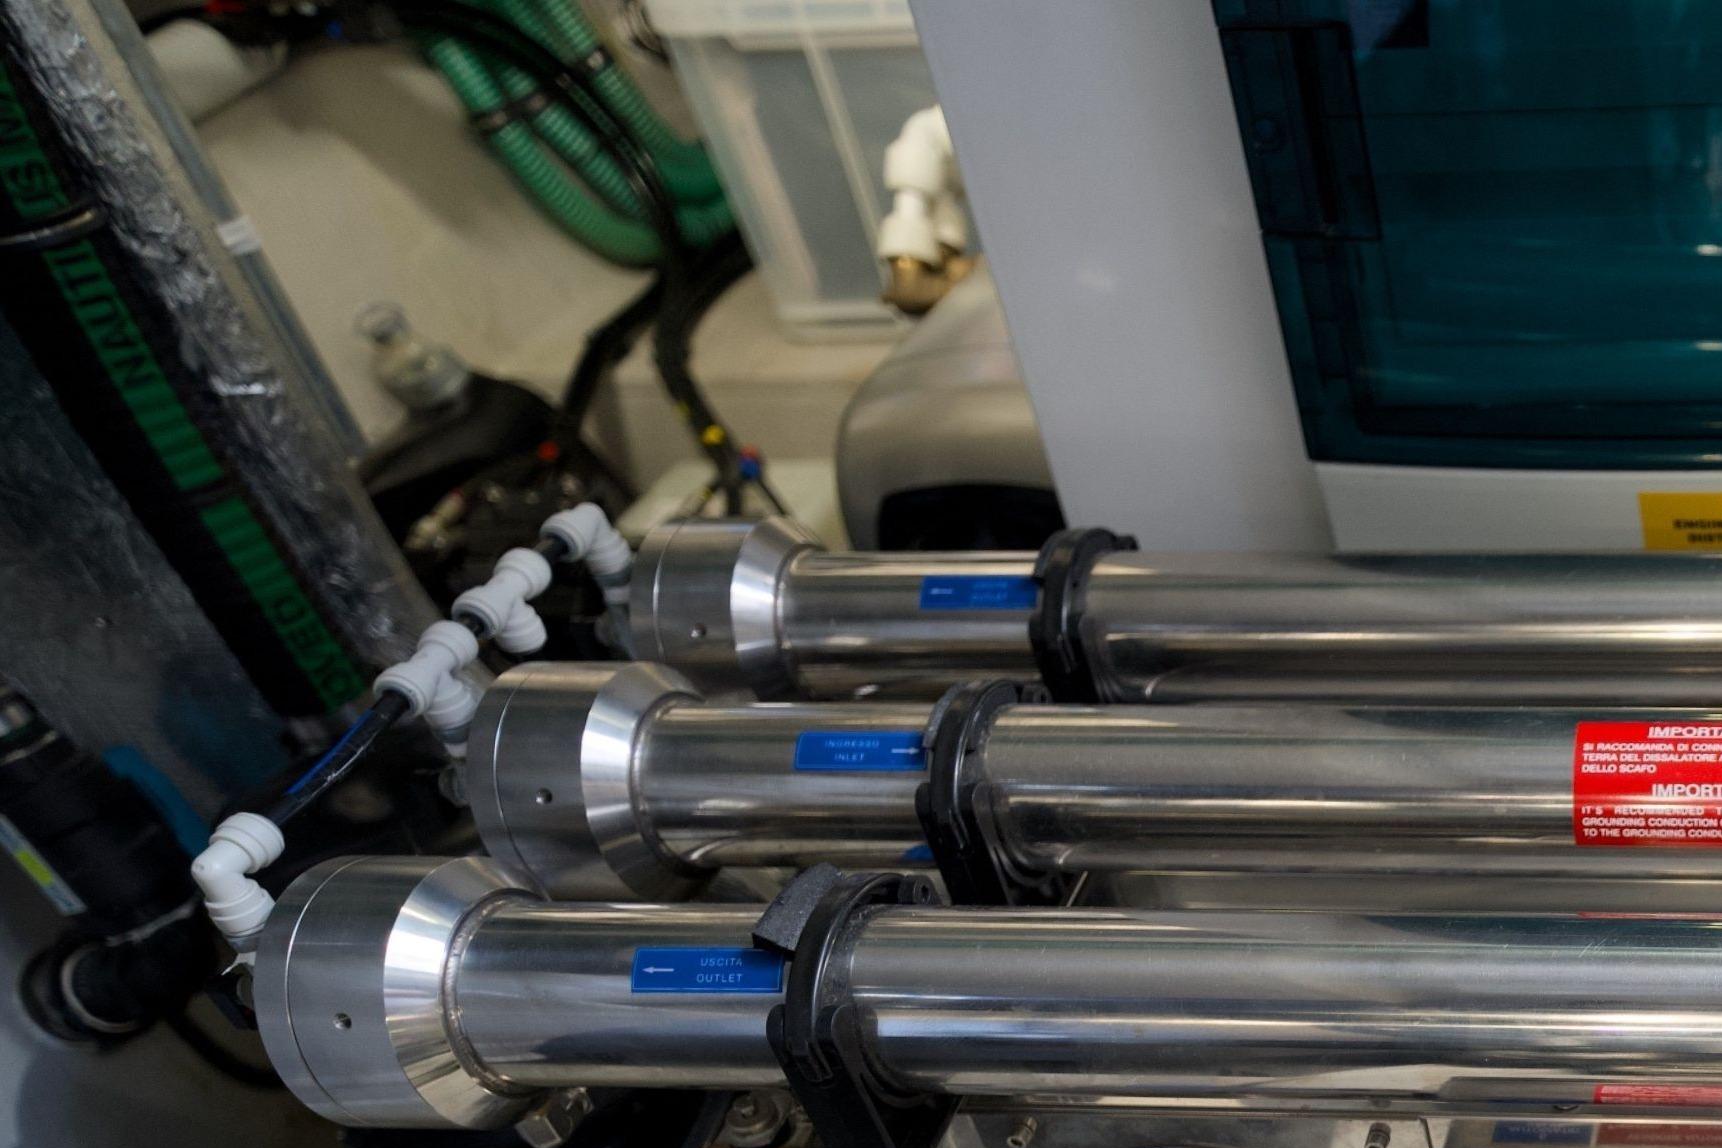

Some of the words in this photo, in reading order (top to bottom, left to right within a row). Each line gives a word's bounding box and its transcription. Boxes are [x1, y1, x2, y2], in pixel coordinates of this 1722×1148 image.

[1582, 743, 1595, 752] SI
[1597, 743, 1674, 752] RACCOMANDA
[1677, 743, 1690, 752] DI
[1583, 753, 1618, 763] TERRA
[1620, 753, 1641, 763] DEL
[1643, 753, 1717, 763] DISSALATORE
[1581, 764, 1617, 774] DELLO
[1618, 764, 1657, 774] SCAFO
[1614, 806, 1704, 816] RECOMMENDED
[1582, 817, 1646, 828] GROUNDING
[1647, 817, 1718, 828] CONDUCTION
[1584, 828, 1598, 838] TO
[1600, 828, 1621, 838] THE
[1622, 828, 1687, 839] GROUNDING
[700, 957, 743, 967] USCITA
[696, 973, 743, 983] OUTLET
